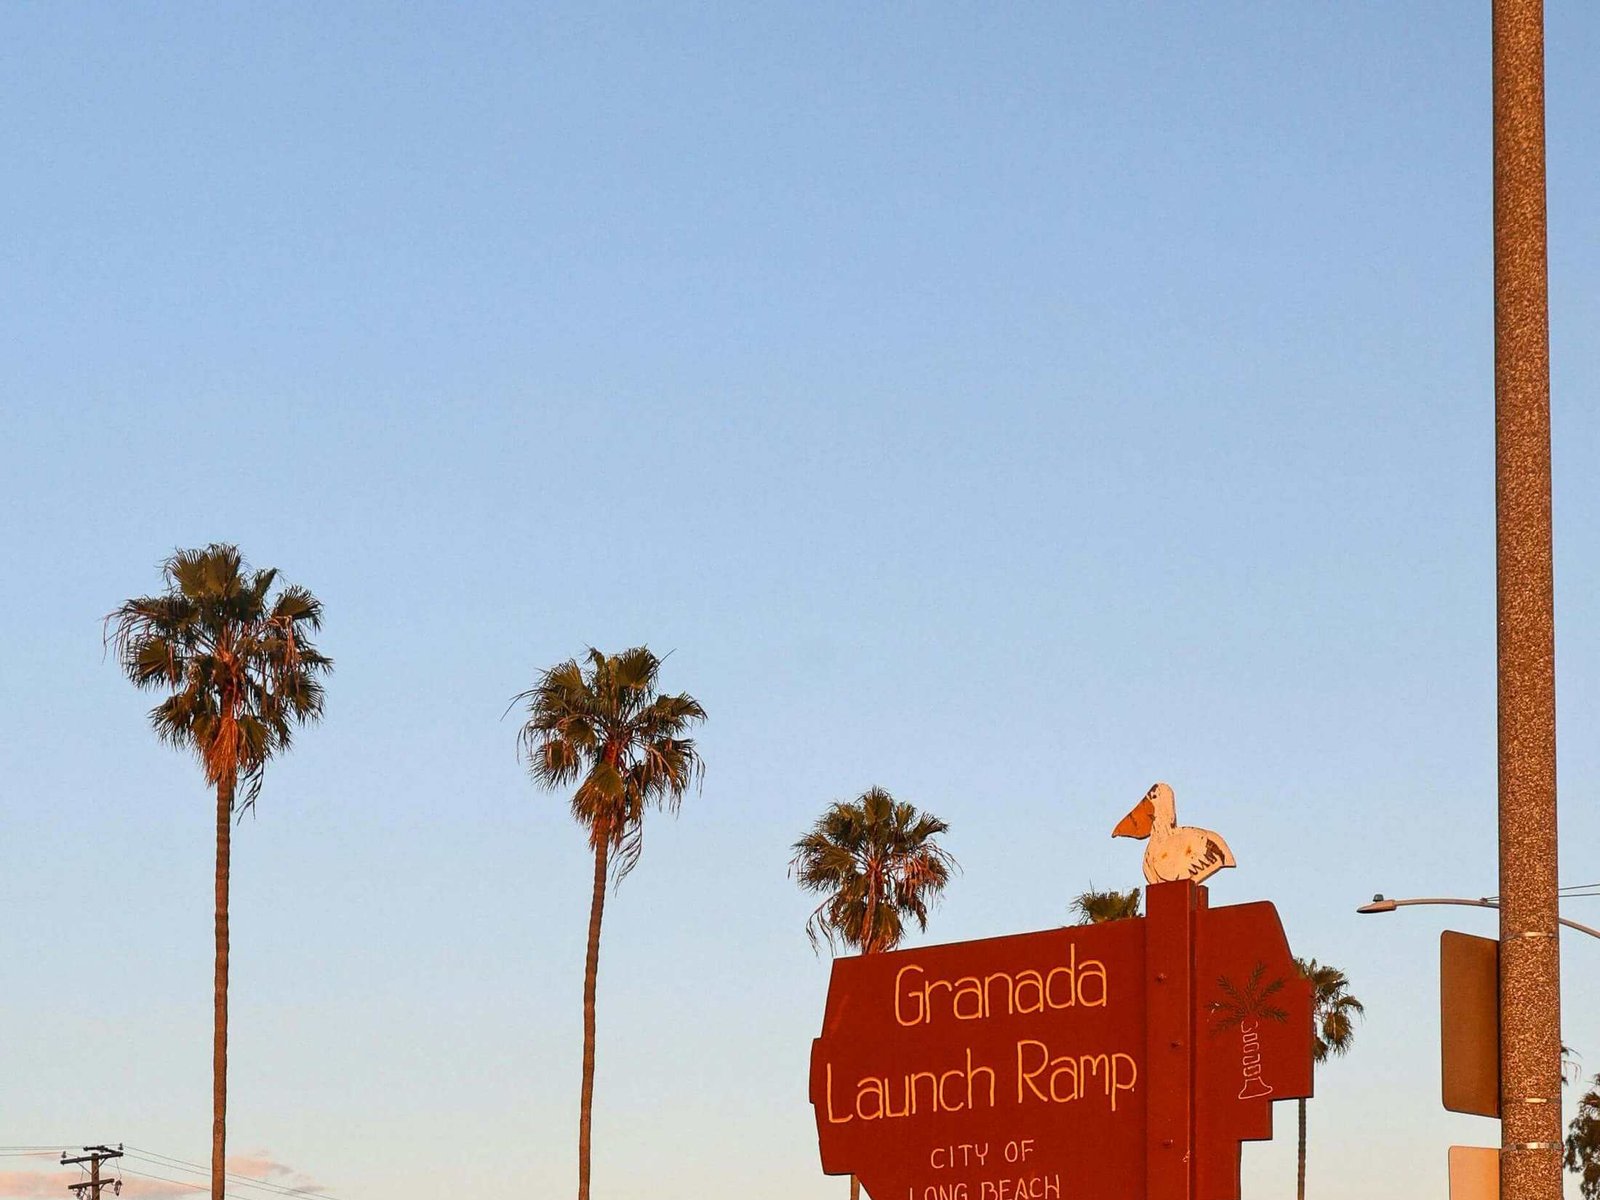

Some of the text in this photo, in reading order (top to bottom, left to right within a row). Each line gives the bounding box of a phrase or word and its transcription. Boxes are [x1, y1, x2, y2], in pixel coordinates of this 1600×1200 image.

[894, 943, 1108, 1027] Granada
[826, 1039, 1138, 1124] Launch Ramp
[930, 1139, 1036, 1170] CITY OF
